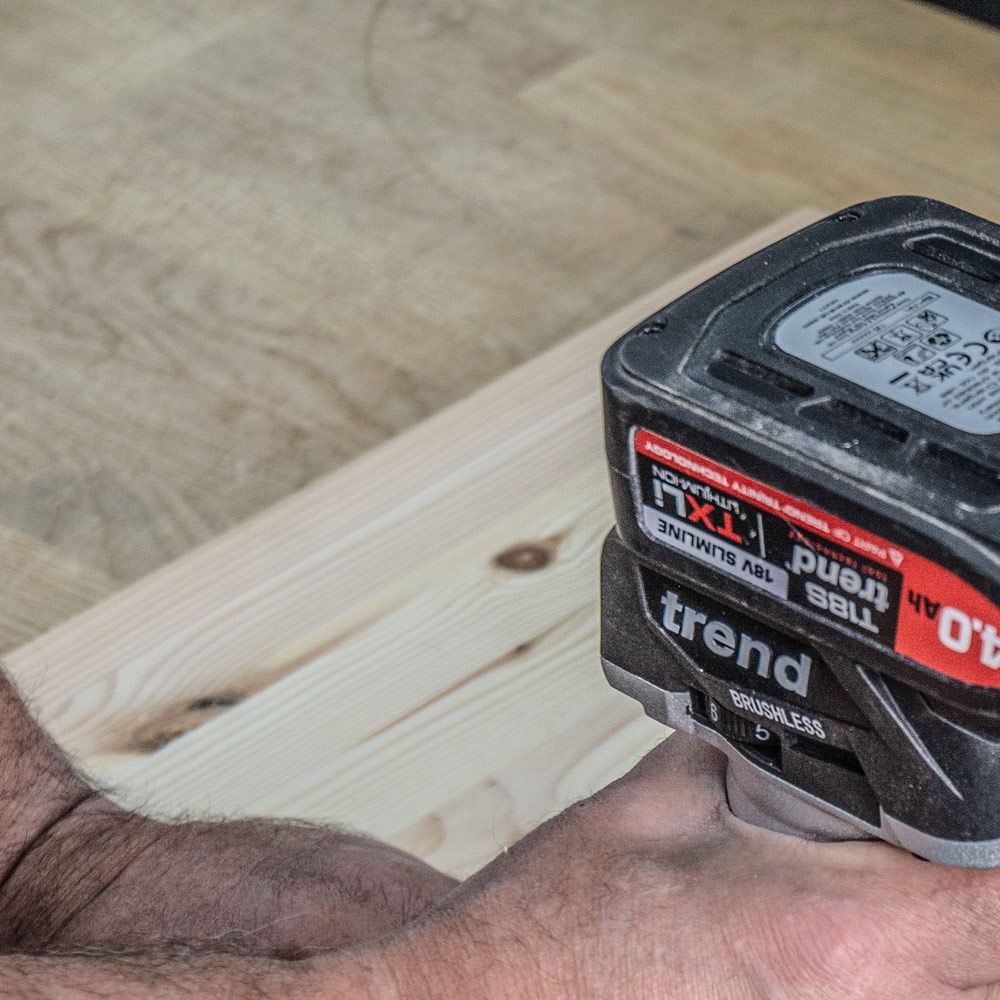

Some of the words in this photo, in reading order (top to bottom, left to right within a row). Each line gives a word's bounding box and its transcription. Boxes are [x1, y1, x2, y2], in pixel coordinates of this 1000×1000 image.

[658, 518, 735, 566] SLIMLINE
[743, 560, 774, 583] 18V
[791, 545, 889, 612] trend
[660, 589, 812, 698] trend
[729, 689, 826, 739] BRUSHLESS
[755, 724, 770, 741] 5
